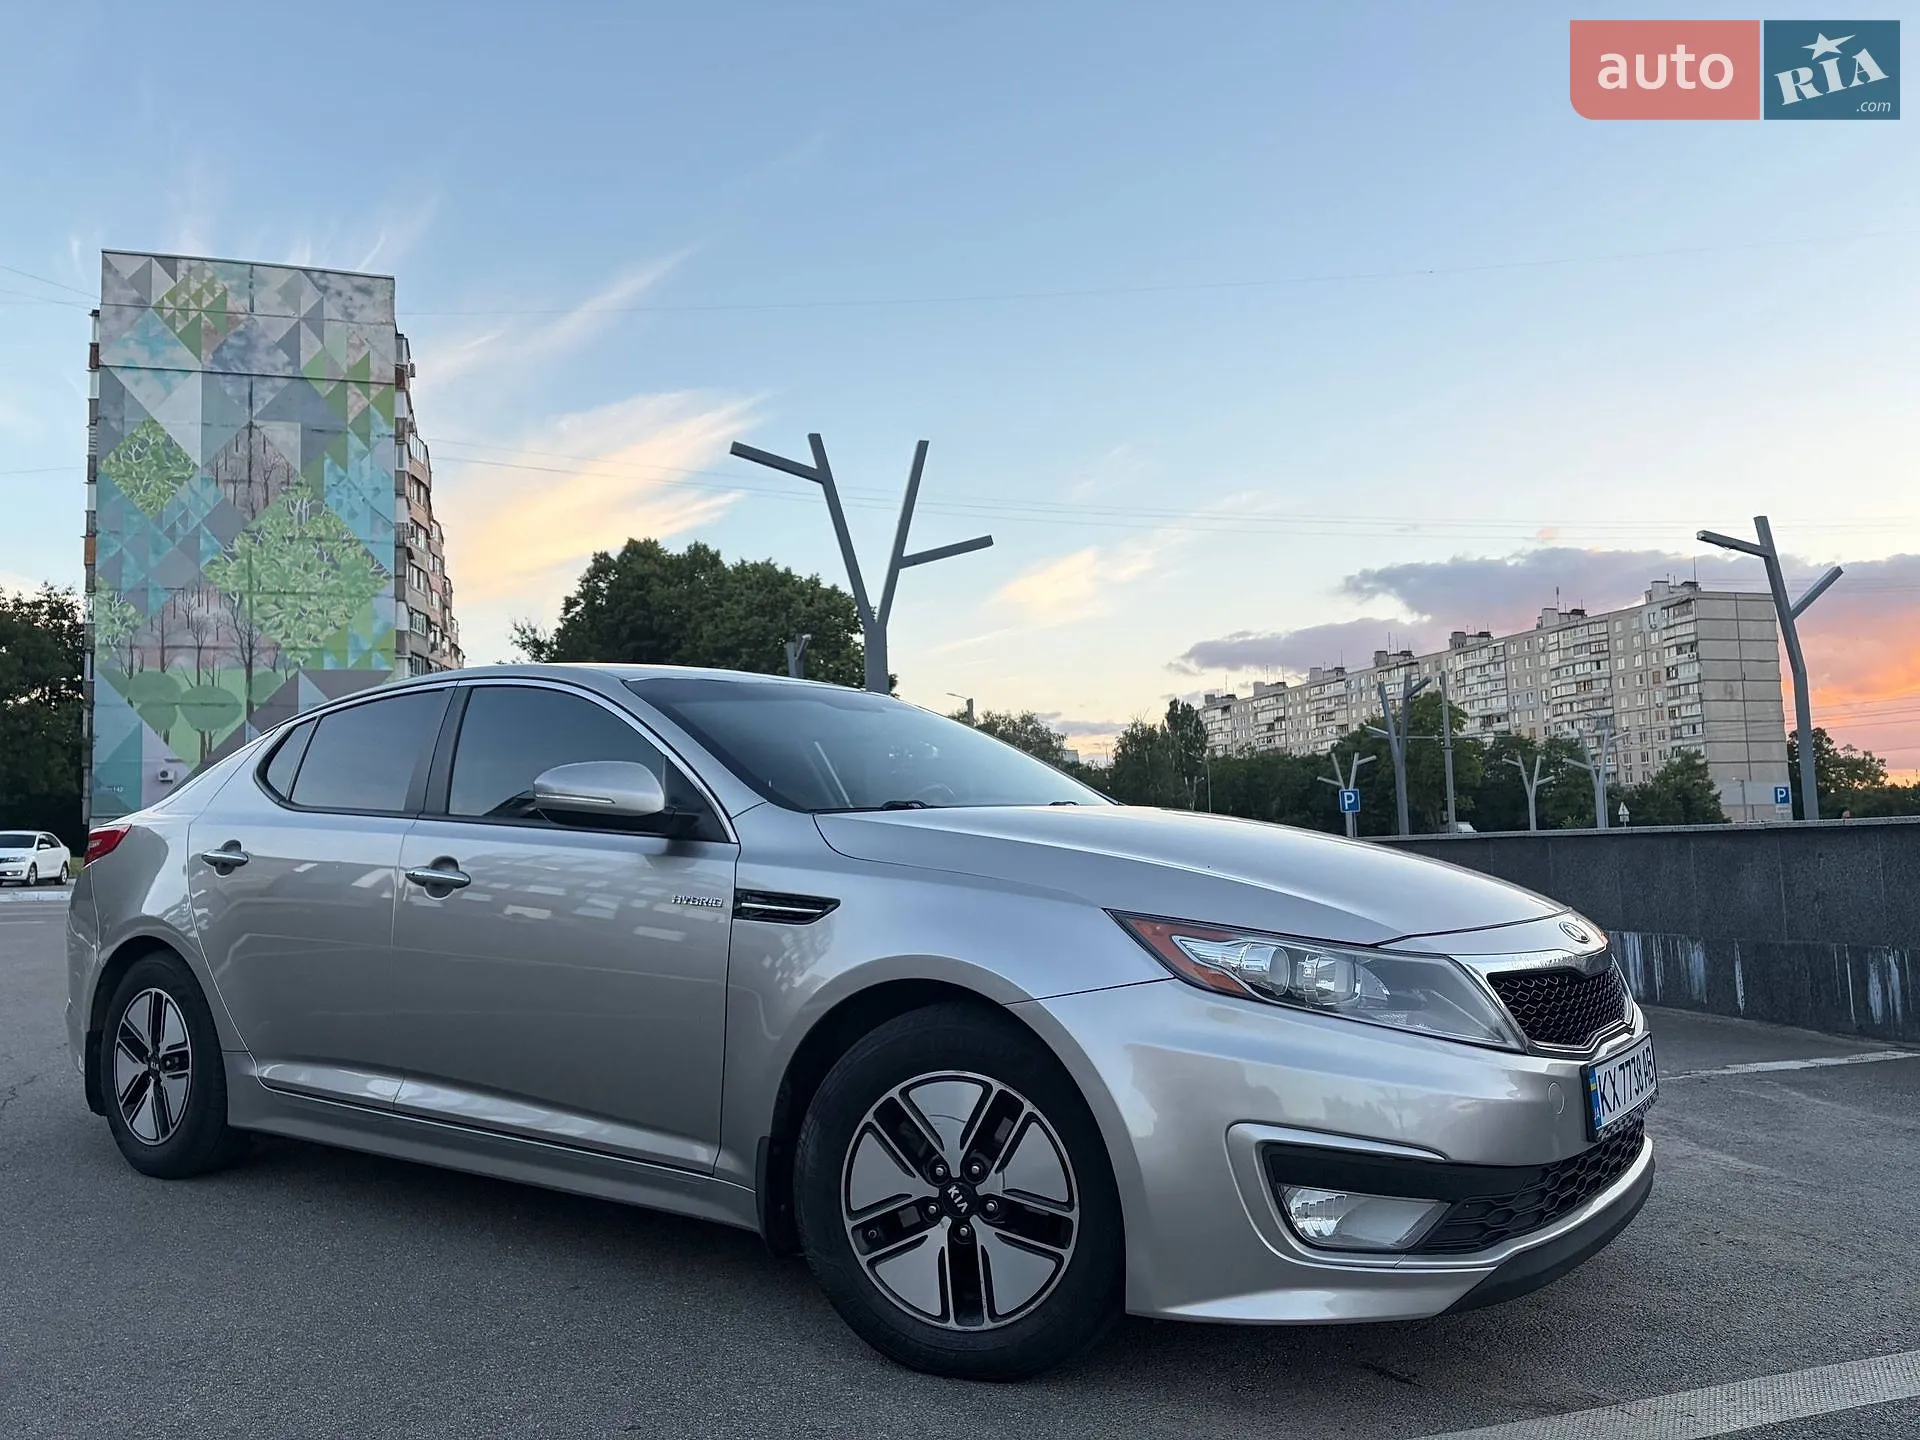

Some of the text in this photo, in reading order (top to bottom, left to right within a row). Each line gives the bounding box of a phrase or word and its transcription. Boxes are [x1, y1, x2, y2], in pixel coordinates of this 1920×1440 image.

[1343, 792, 1355, 810] P
[1777, 788, 1787, 803] P
[671, 895, 723, 907] HYBRID
[1597, 1066, 1621, 1117] KX
[947, 1185, 968, 1213] KIA
